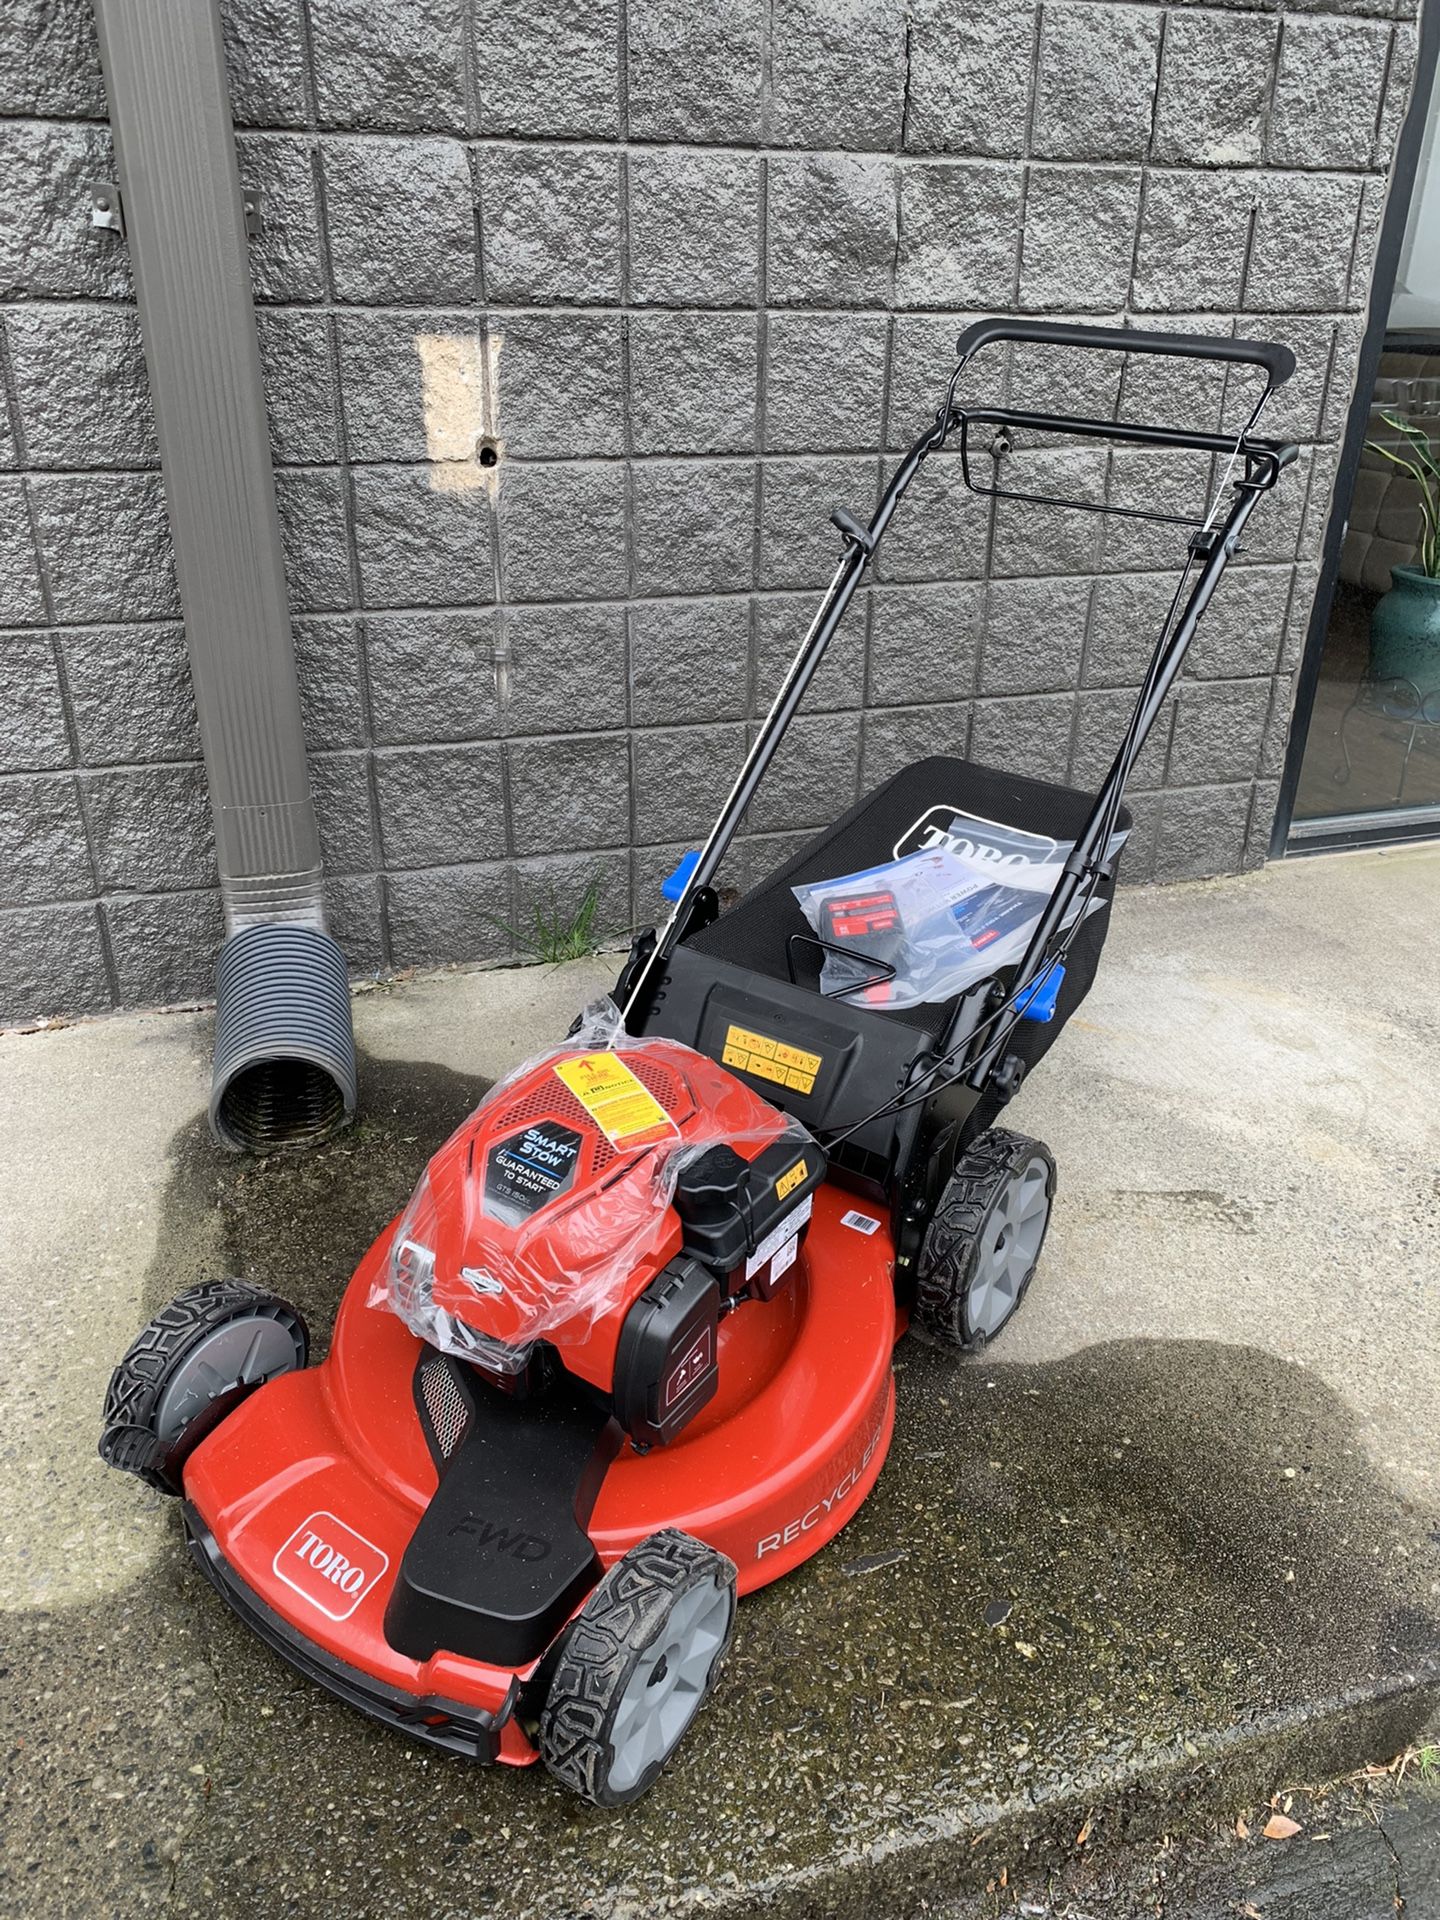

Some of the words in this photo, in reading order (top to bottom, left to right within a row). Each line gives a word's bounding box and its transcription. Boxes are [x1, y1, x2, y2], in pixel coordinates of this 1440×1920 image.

[520, 1141, 563, 1167] STOW
[524, 1129, 577, 1158] SMART
[495, 1155, 560, 1191] GUARANTEED
[503, 1169, 515, 1180] TO
[496, 1183, 512, 1194] GTS
[757, 1424, 881, 1559] RECYCLER
[447, 1513, 552, 1562] FWD
